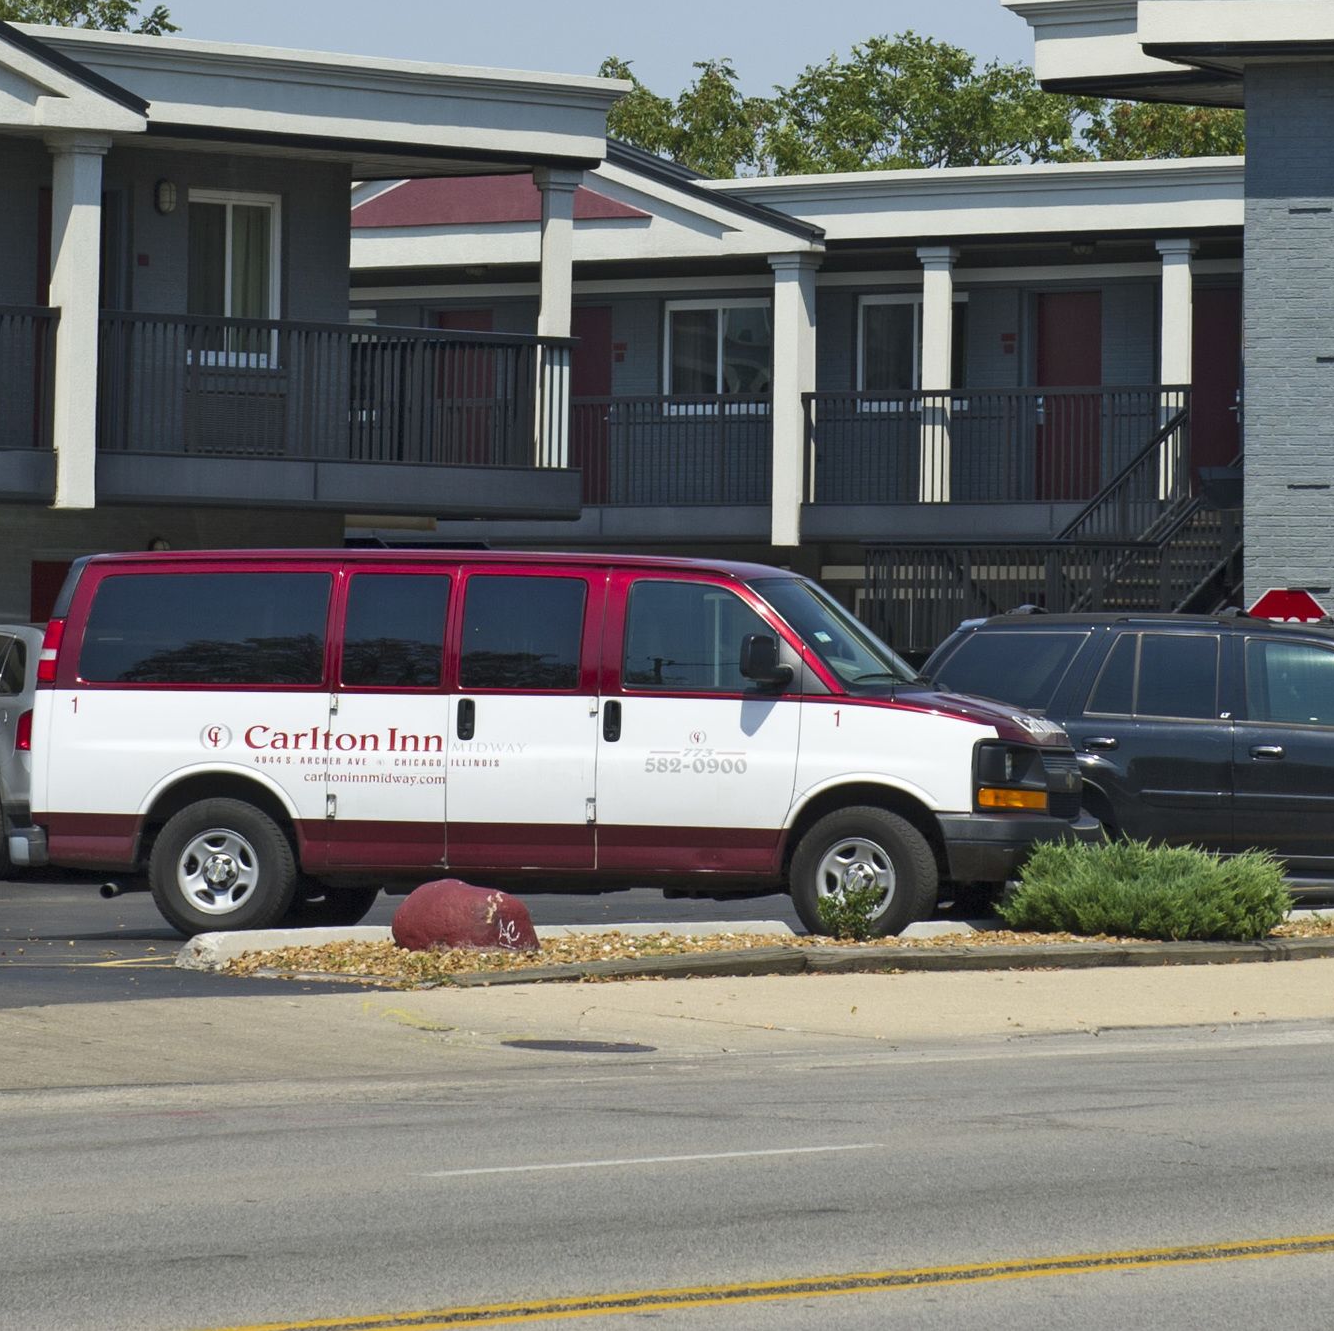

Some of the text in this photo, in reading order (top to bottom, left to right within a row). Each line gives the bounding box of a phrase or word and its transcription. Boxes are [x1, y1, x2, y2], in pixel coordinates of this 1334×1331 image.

[70, 696, 79, 714] 1
[832, 709, 842, 727] 1
[244, 725, 528, 754] Carlton Inn MIDWAY
[682, 748, 714, 757] 773
[299, 756, 342, 766] ARCHER
[347, 757, 368, 766] AVE
[394, 758, 446, 768] CHICAGO,
[450, 758, 501, 768] ILLINOIS
[644, 757, 748, 775] 582-0900
[303, 771, 446, 787] carltoninnmidway.com
